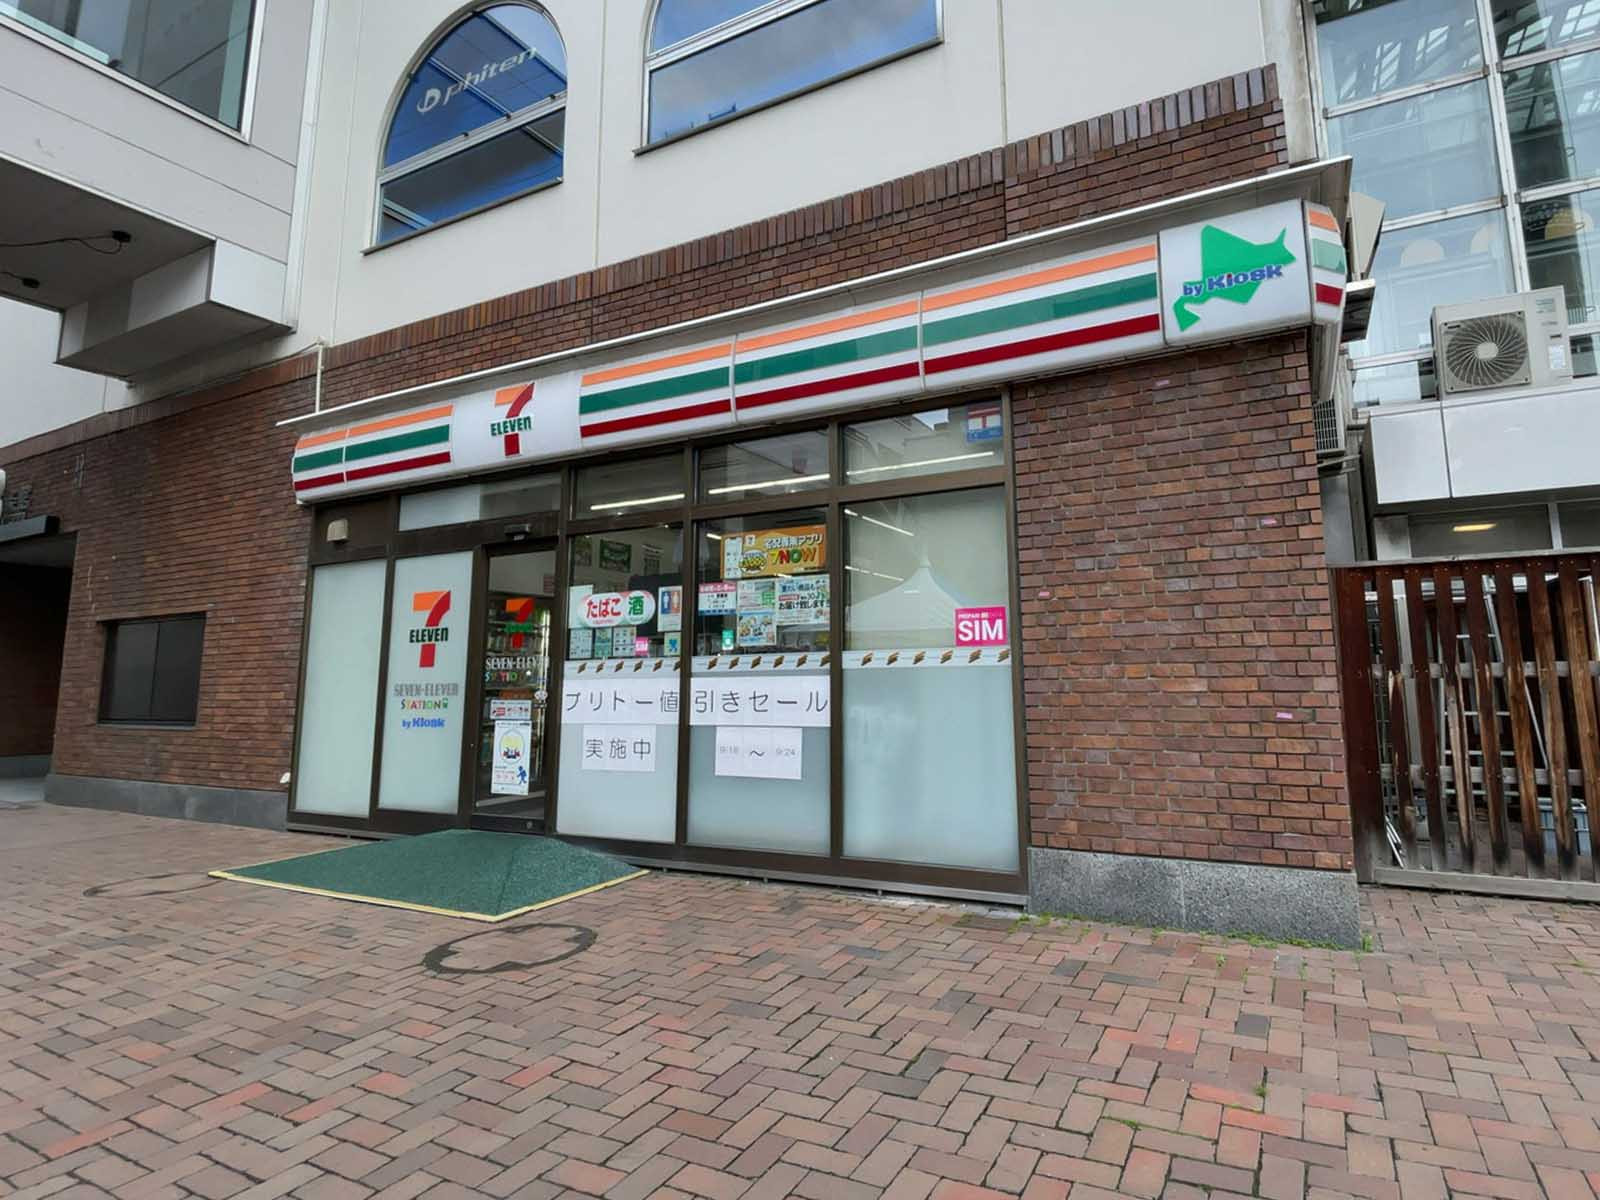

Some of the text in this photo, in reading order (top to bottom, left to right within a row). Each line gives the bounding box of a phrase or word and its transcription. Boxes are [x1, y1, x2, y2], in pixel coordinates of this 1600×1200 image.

[442, 47, 538, 106] phiten
[1183, 265, 1284, 296] by Kiosk
[495, 382, 535, 457] 7
[586, 595, 645, 618] たばこ 酒
[412, 590, 451, 668] 7
[958, 618, 1004, 641] SIM
[694, 690, 829, 713] 引きセール
[586, 738, 652, 760] 実施中
